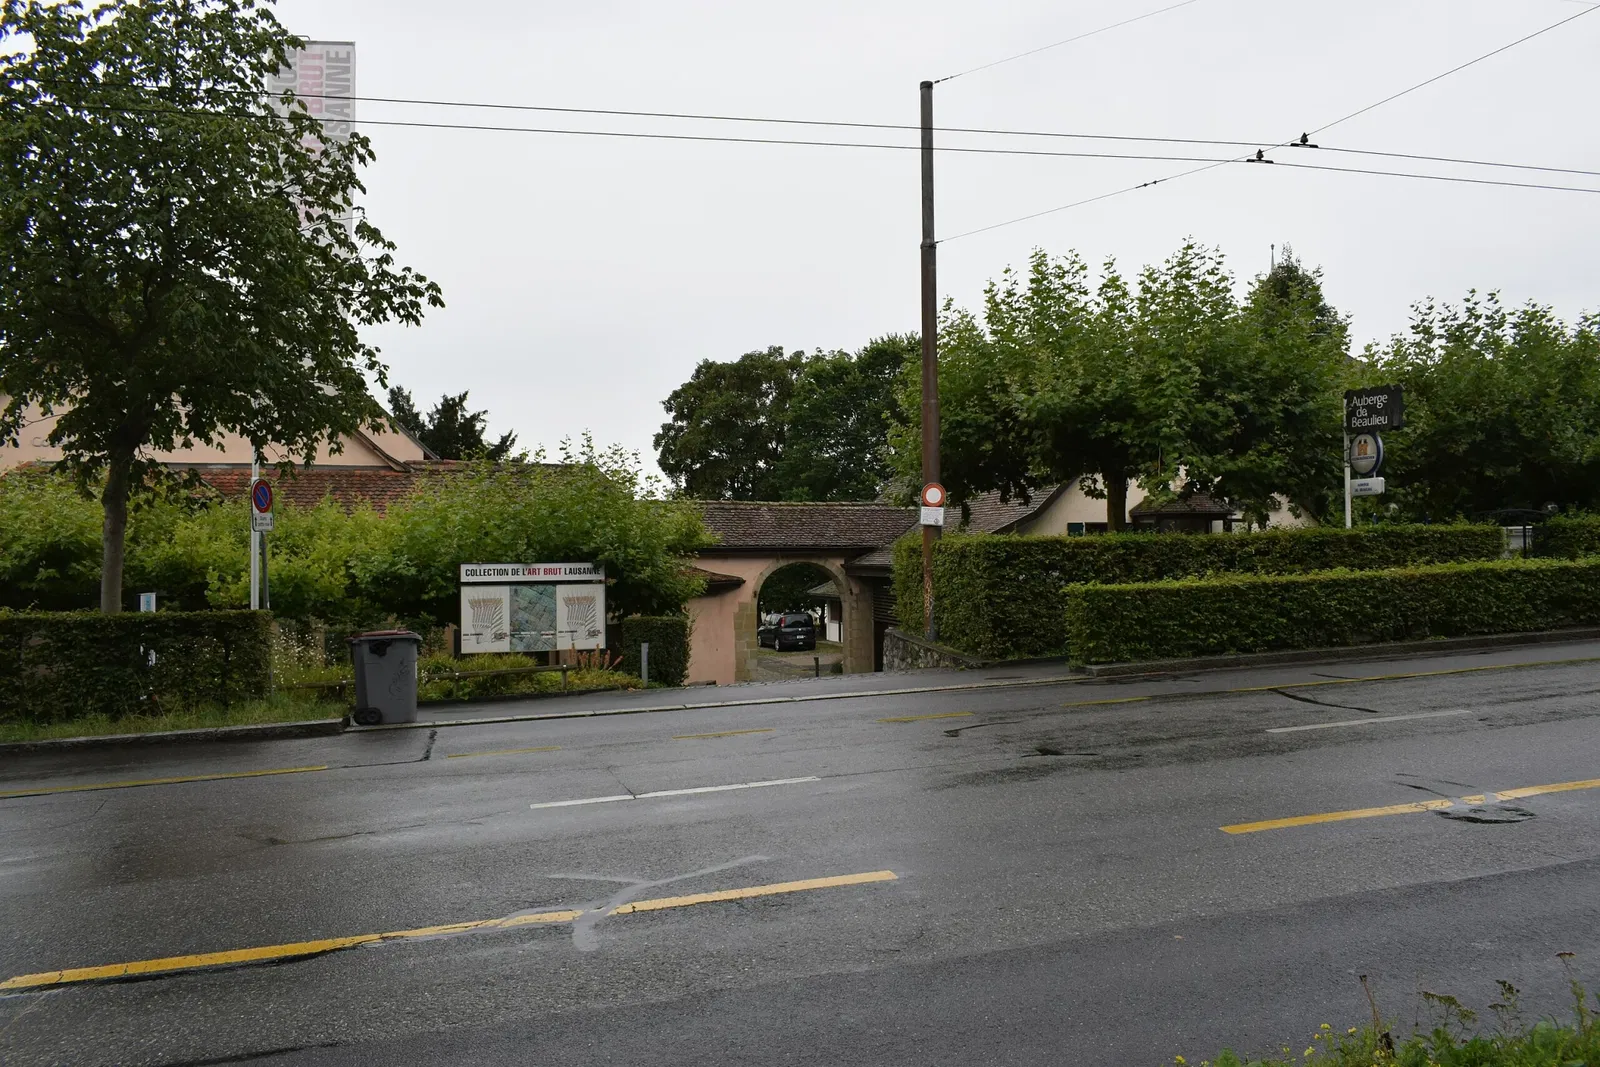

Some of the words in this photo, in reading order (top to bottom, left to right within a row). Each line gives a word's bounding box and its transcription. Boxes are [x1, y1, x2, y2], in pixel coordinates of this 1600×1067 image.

[325, 50, 350, 144] SANNE
[1351, 394, 1388, 409] Auberge
[1356, 406, 1368, 418] de
[1351, 414, 1388, 428] Beaulieu
[465, 568, 509, 577] COLLECTION
[511, 568, 520, 576] DE
[522, 567, 541, 576] L'ART
[543, 567, 562, 576] BRUT
[564, 567, 601, 576] LAUSANNE
